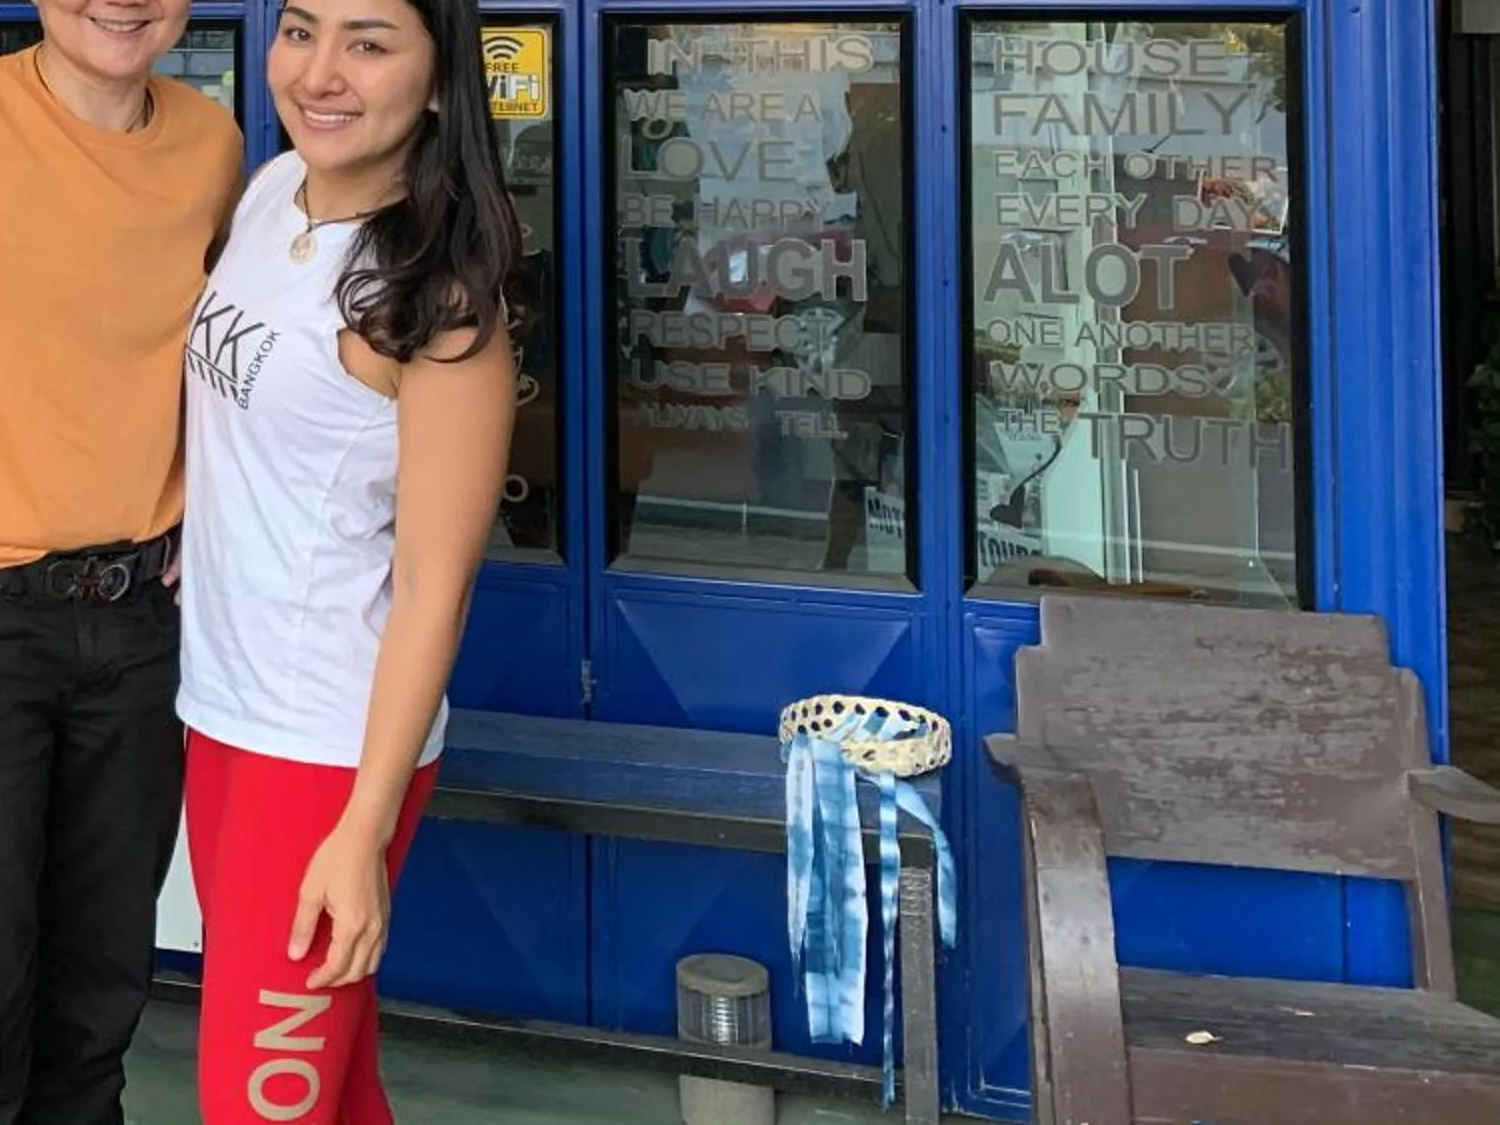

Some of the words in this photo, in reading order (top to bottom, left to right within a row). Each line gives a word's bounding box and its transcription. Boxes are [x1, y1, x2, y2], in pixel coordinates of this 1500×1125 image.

[649, 38, 703, 74] IN
[736, 37, 873, 72] THIS
[994, 40, 1228, 77] HOUSE
[624, 89, 686, 119] WE
[703, 92, 784, 123] ARE
[793, 91, 823, 124] A
[993, 91, 1250, 137] FAMILY
[621, 137, 797, 182] LOVE
[993, 150, 1107, 180] EACH
[1122, 153, 1278, 184] OTHER
[624, 196, 675, 225] BE
[699, 195, 833, 229] HAPPY
[995, 193, 1148, 229] EVERY
[1172, 195, 1263, 233] DAY
[625, 237, 867, 302] LAUGH
[983, 241, 1193, 309] ALOT
[630, 310, 830, 355] RESPECT
[986, 319, 1062, 347] ONE
[1074, 321, 1256, 352] ANOTHER
[237, 330, 282, 410] BANGKOK
[632, 361, 732, 394] USE
[753, 369, 872, 400] KIND
[990, 363, 1211, 398] WORDS
[1000, 409, 1061, 435] THE
[1078, 411, 1290, 472] TRUTH
